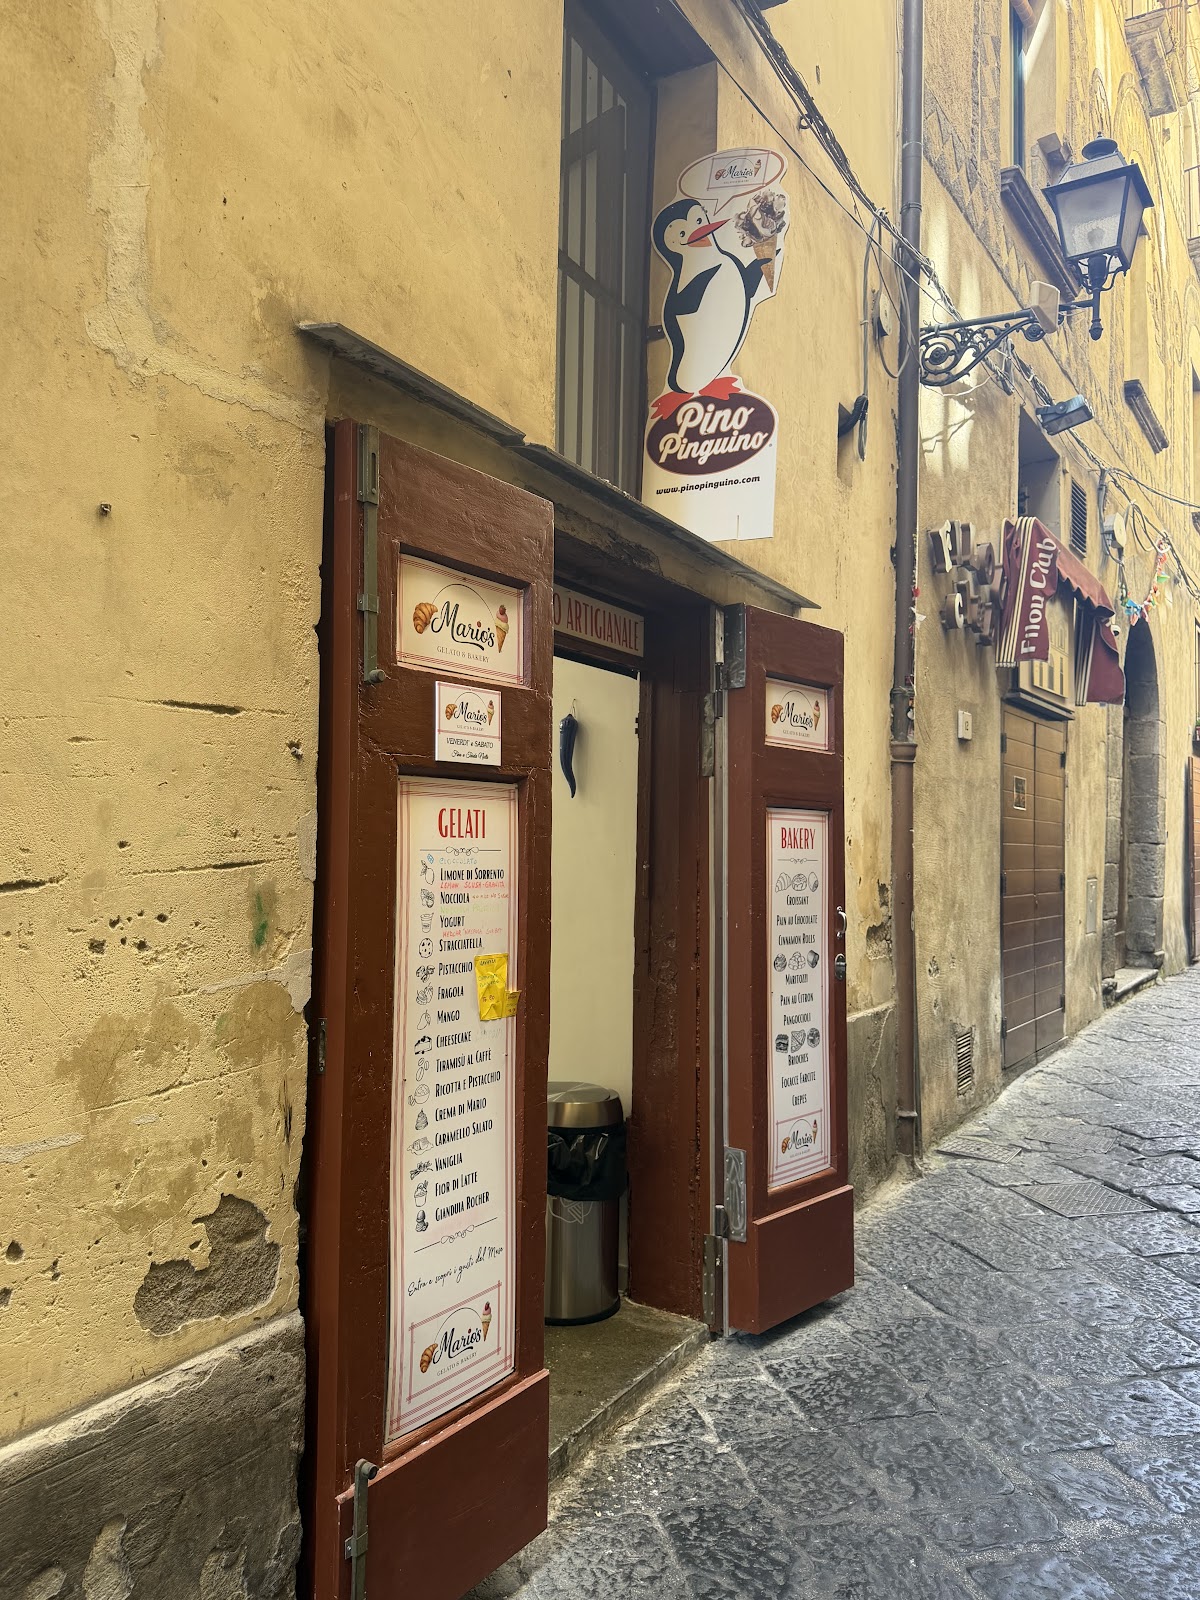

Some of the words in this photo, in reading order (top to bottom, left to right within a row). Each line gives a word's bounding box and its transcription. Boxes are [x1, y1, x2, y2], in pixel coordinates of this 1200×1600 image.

[722, 165, 753, 179] Mario's
[676, 401, 755, 439] Pino
[659, 430, 769, 465] Pinguino
[656, 476, 760, 495] www.pinopinguino.com
[1030, 537, 1057, 589] Club
[431, 601, 495, 651] Mario's
[567, 597, 639, 651] ARTIGIANALE
[1020, 594, 1045, 655] Filou
[437, 646, 462, 658] GELATO
[467, 652, 490, 663] BAKERY
[454, 702, 487, 725] Mario's
[780, 702, 813, 730] Mario's
[438, 808, 485, 838] GELATI
[781, 827, 816, 849] BAKERY
[441, 868, 464, 880] LIMONE
[467, 870, 473, 880] DI
[475, 868, 505, 879] SORRENTO
[441, 892, 470, 904] NOCCIOLA
[787, 895, 809, 906] CROISSANT
[440, 915, 465, 928] YOGURT
[777, 915, 787, 926] PAIN
[788, 916, 793, 925] AU
[795, 914, 818, 925] CHOCOLATE
[439, 938, 482, 952] STRACCIATELLA
[778, 935, 801, 946] CINNAMON
[802, 933, 816, 944] ROLLS
[439, 962, 473, 976] PISTACCHIO
[438, 986, 464, 1000] FRAGOLA
[781, 995, 790, 1006] PAIN
[792, 995, 797, 1004] AU
[798, 992, 814, 1003] CITRON
[437, 1010, 460, 1024] MANGO
[784, 1013, 811, 1026] PANGOCCIOLI
[437, 1031, 471, 1048] CHEESECAKE
[467, 1054, 473, 1065] AL
[788, 1053, 809, 1066] BRIOCHES
[436, 1080, 461, 1097] RICOTTA
[463, 1079, 466, 1090] E
[469, 1071, 501, 1089] PISTACCHIO
[781, 1074, 799, 1089] FOCACCE
[800, 1071, 816, 1083] FARCITE
[792, 1094, 807, 1106] CREPES
[435, 1106, 456, 1122] CREMA
[458, 1104, 465, 1115] DI
[467, 1098, 487, 1112] MARIO
[435, 1126, 471, 1147] CARAMELLO
[472, 1120, 493, 1134] SALATO
[788, 1130, 813, 1150] Mario's
[435, 1153, 463, 1172] VANIGLIA
[435, 1182, 450, 1197] FIOR
[453, 1178, 459, 1190] DI
[461, 1171, 478, 1187] LATTE
[435, 1201, 465, 1221] GIANDUIA
[466, 1192, 490, 1210] ROCHER
[408, 1278, 428, 1297] Entra
[456, 1255, 474, 1283] gusti
[475, 1246, 487, 1263] del
[433, 1327, 481, 1365] Mario's
[436, 1361, 456, 1377] GELATO
[460, 1352, 477, 1365] BAKERY
